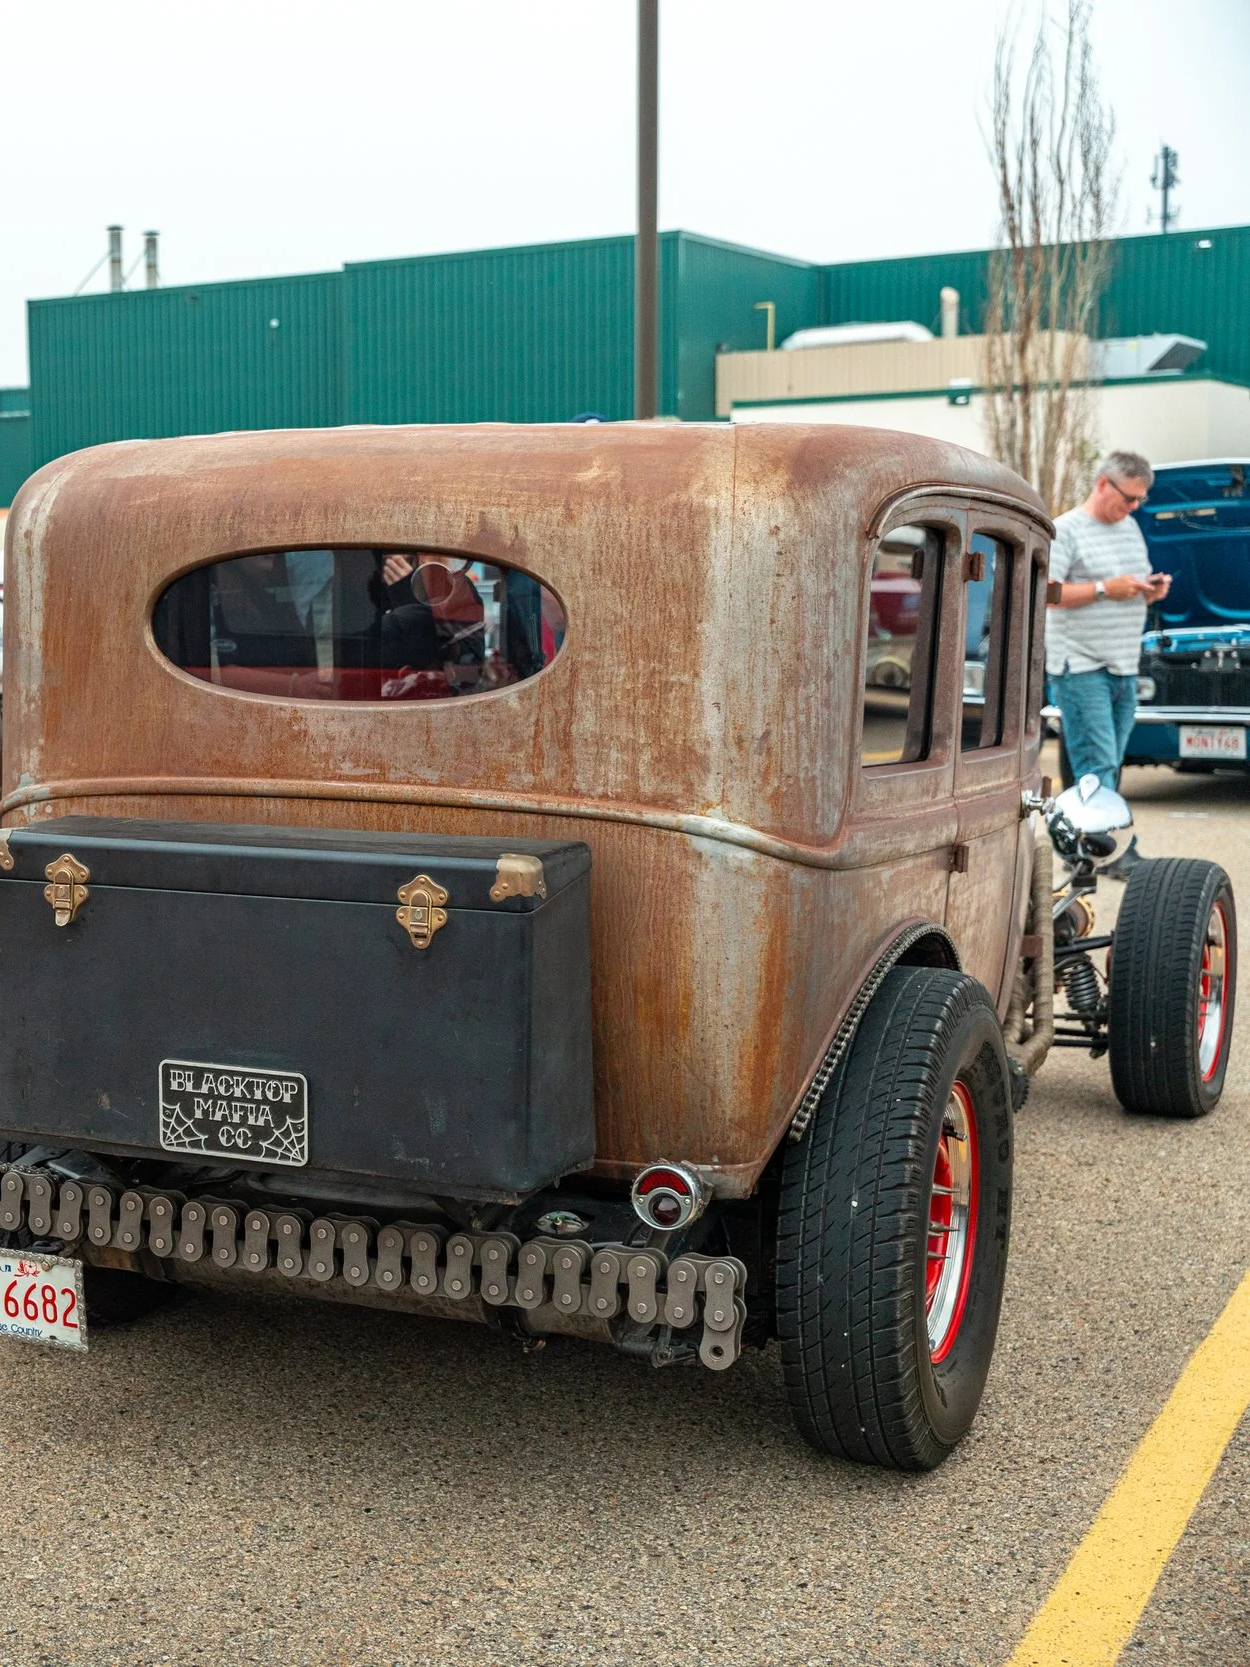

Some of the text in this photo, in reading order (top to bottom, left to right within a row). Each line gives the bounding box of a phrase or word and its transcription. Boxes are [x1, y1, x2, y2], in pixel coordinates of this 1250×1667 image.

[170, 1069, 298, 1103] BLACKTOP
[194, 1097, 275, 1128] MAFIA
[219, 1126, 252, 1149] CC
[10, 1323, 43, 1337] Country
